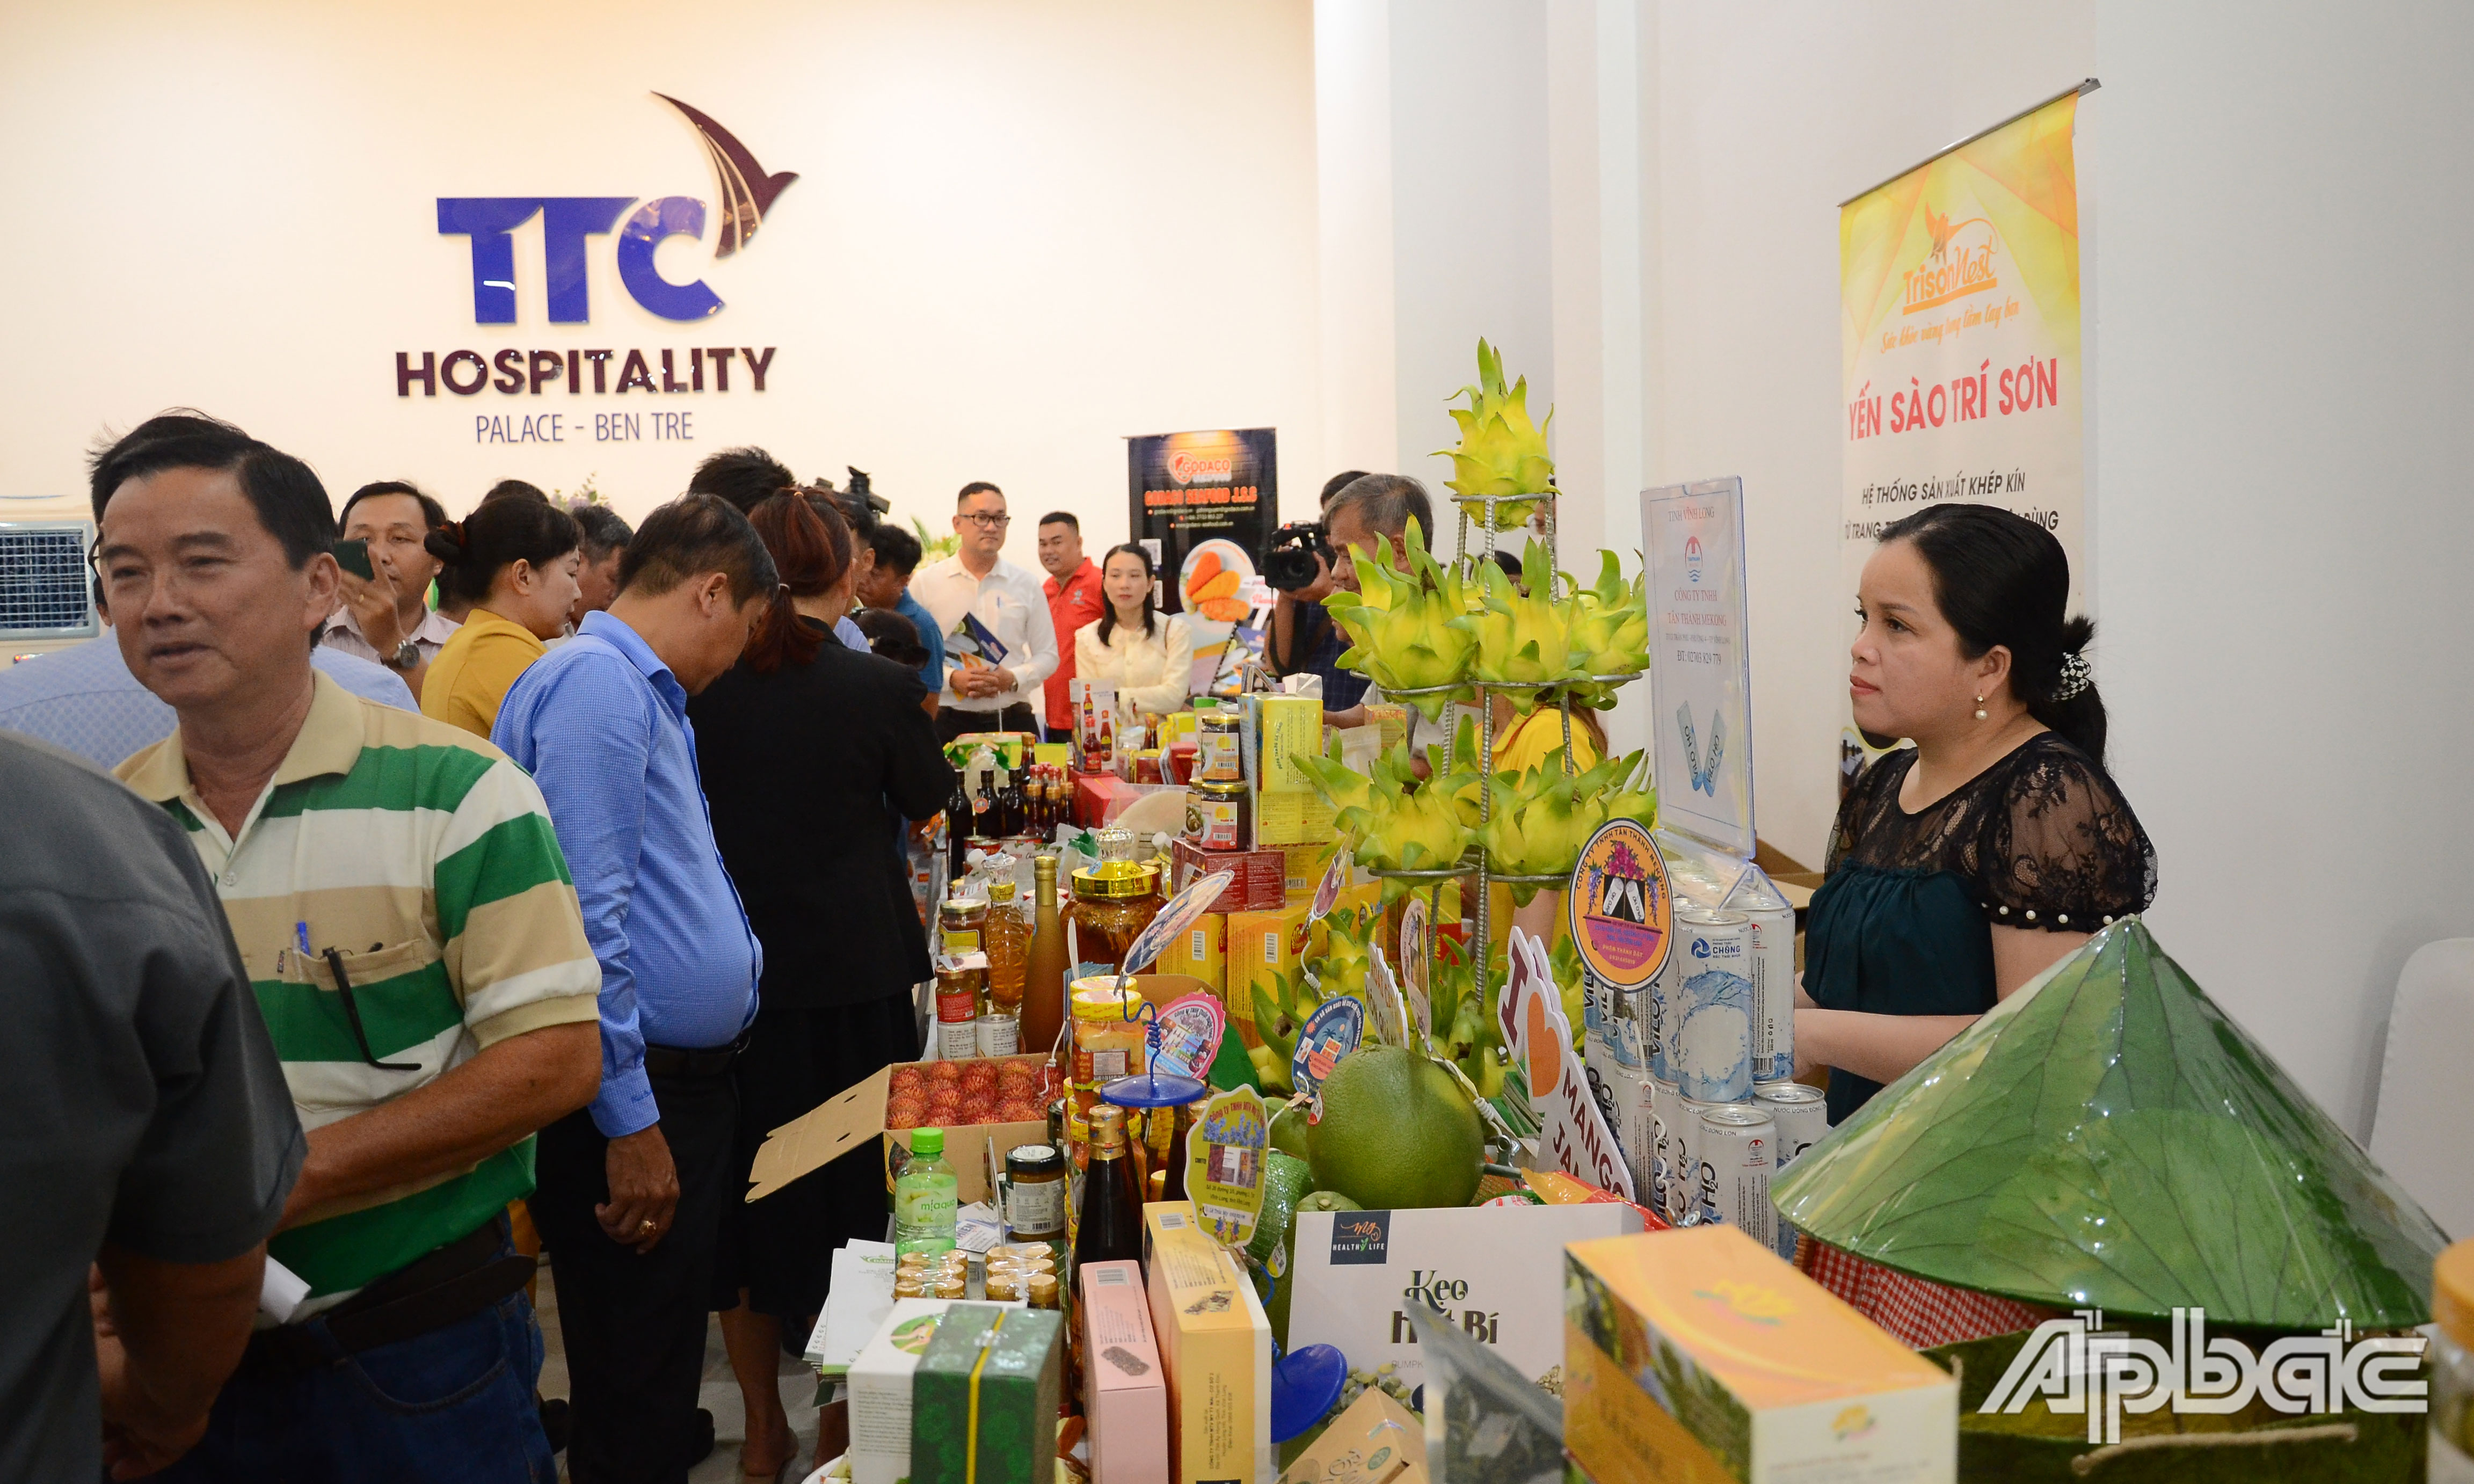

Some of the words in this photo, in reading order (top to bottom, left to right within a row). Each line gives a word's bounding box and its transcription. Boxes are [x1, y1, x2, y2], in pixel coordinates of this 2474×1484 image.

[436, 195, 725, 324] TTC
[1985, 303, 2002, 329] tay
[395, 347, 776, 397] HOSPITALITY
[1850, 380, 1881, 441] YẾN
[1891, 376, 1946, 433] SÀO
[1952, 358, 1990, 423] TRÍ
[1999, 355, 2057, 416] SƠN
[476, 414, 564, 443] PALACE
[595, 413, 641, 442] BEN
[651, 412, 694, 440] TRE
[1183, 460, 1231, 472] GODACO
[1862, 483, 1874, 509] HỆ
[1876, 478, 1917, 503] THỐNG
[1922, 476, 1943, 499] SẢN
[1945, 470, 1966, 497] XUẤT
[1969, 470, 2003, 495] KHÉP
[2006, 468, 2026, 492] KÍN
[1699, 506, 1715, 520] LONG
[1852, 522, 1881, 540] TRANG
[1675, 587, 1691, 601] CÔNG
[1692, 590, 1701, 601] TY
[1701, 590, 1718, 602] TNHH
[1701, 614, 1727, 627] MEKONG
[1596, 832, 1614, 847] TNHH
[1649, 854, 1667, 899] MEKONG
[1553, 1121, 1581, 1179] JA
[1464, 1311, 1500, 1343] Bí
[1392, 1361, 1424, 1369] PUMPK
